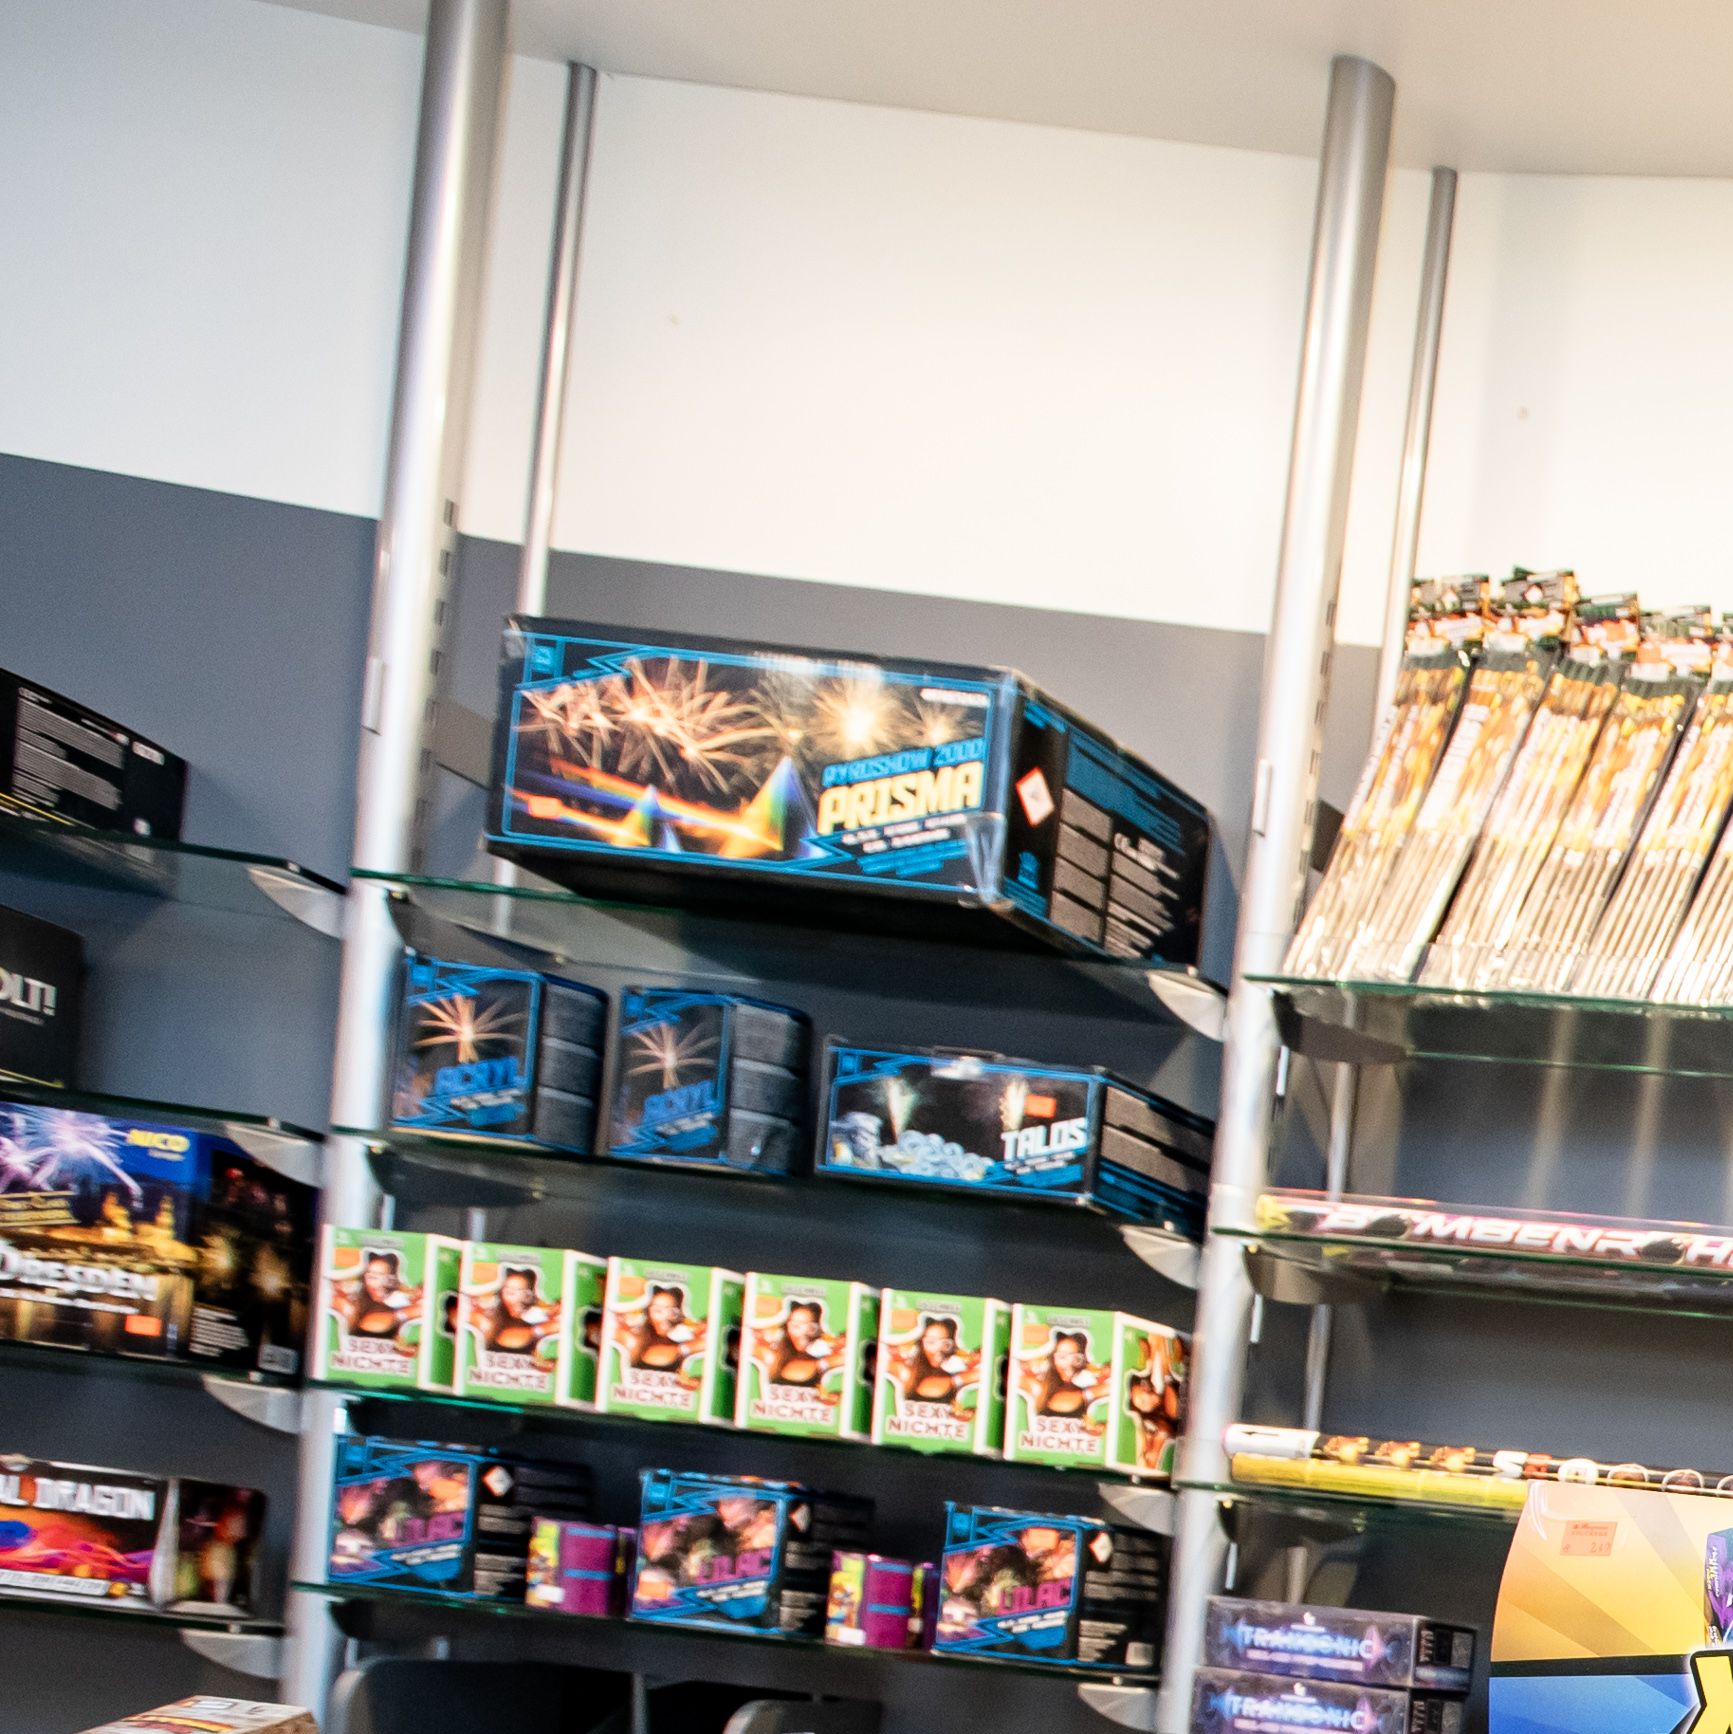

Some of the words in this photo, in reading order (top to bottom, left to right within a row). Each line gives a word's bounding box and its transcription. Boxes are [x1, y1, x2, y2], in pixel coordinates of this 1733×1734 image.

[934, 738, 984, 767] 2000
[817, 761, 984, 836] PRISMA
[1001, 1117, 1089, 1160] TALOS
[331, 1353, 410, 1375] NICHTE
[471, 1369, 548, 1391] NICHTE
[614, 1386, 692, 1409] NICHTE
[753, 1402, 832, 1424] NICHTE
[888, 1419, 967, 1439] NICHTE
[1021, 1433, 1099, 1454] NICHTE
